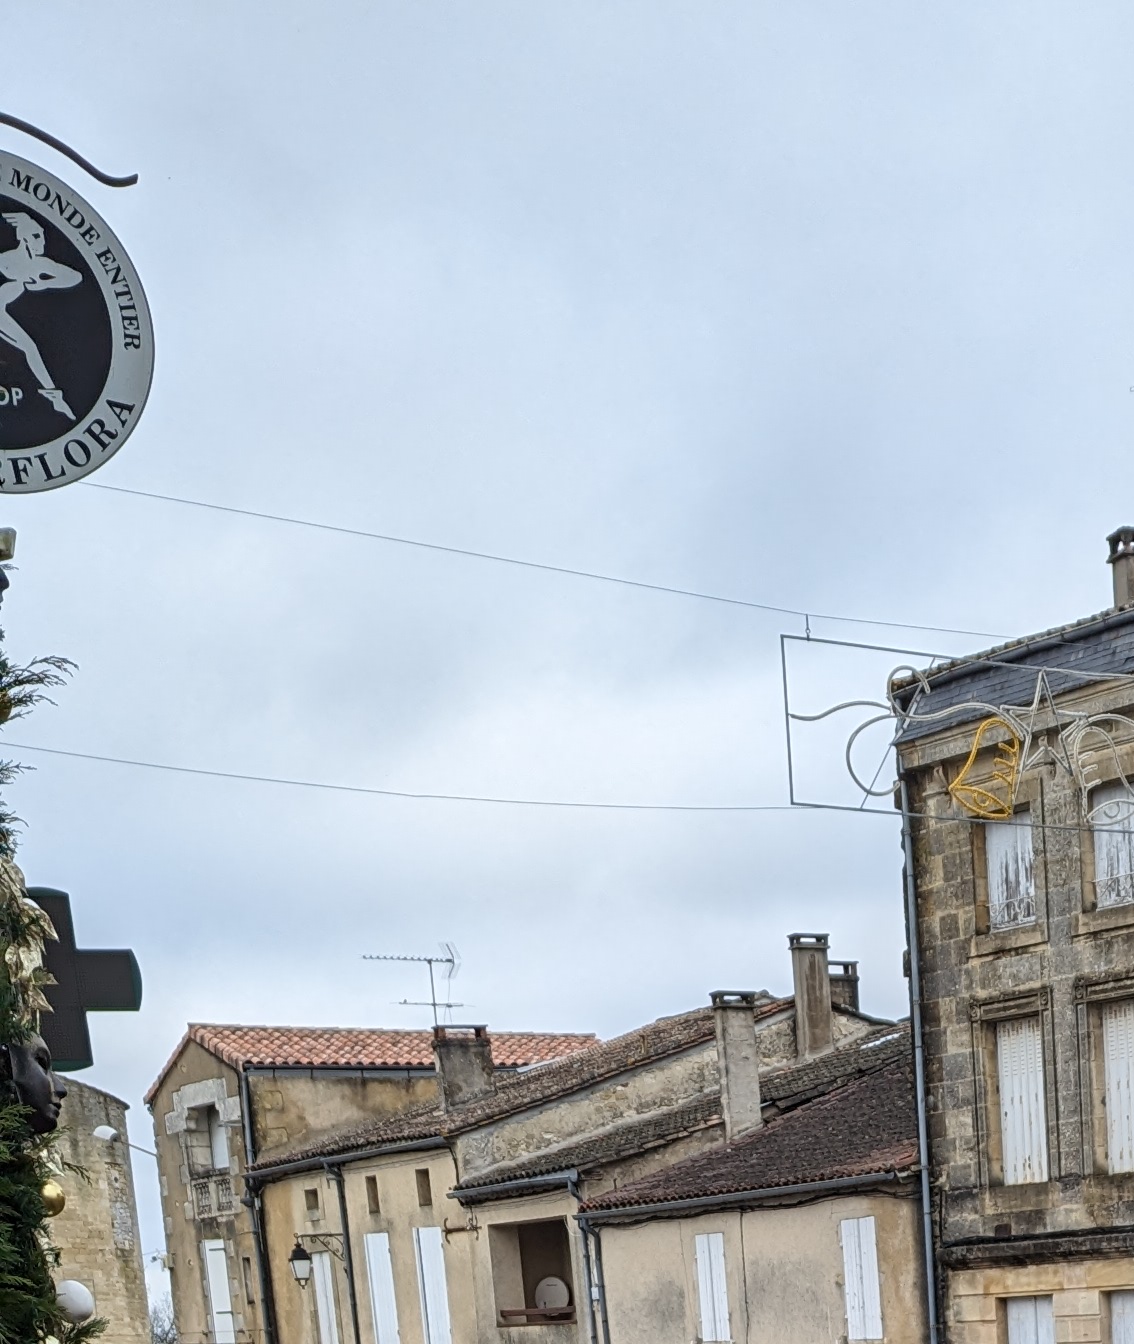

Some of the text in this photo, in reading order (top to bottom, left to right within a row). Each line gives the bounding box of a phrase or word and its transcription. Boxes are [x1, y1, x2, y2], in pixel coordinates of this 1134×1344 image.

[8, 167, 142, 351] MONDE ENTIER
[0, 397, 136, 489] FLORA
